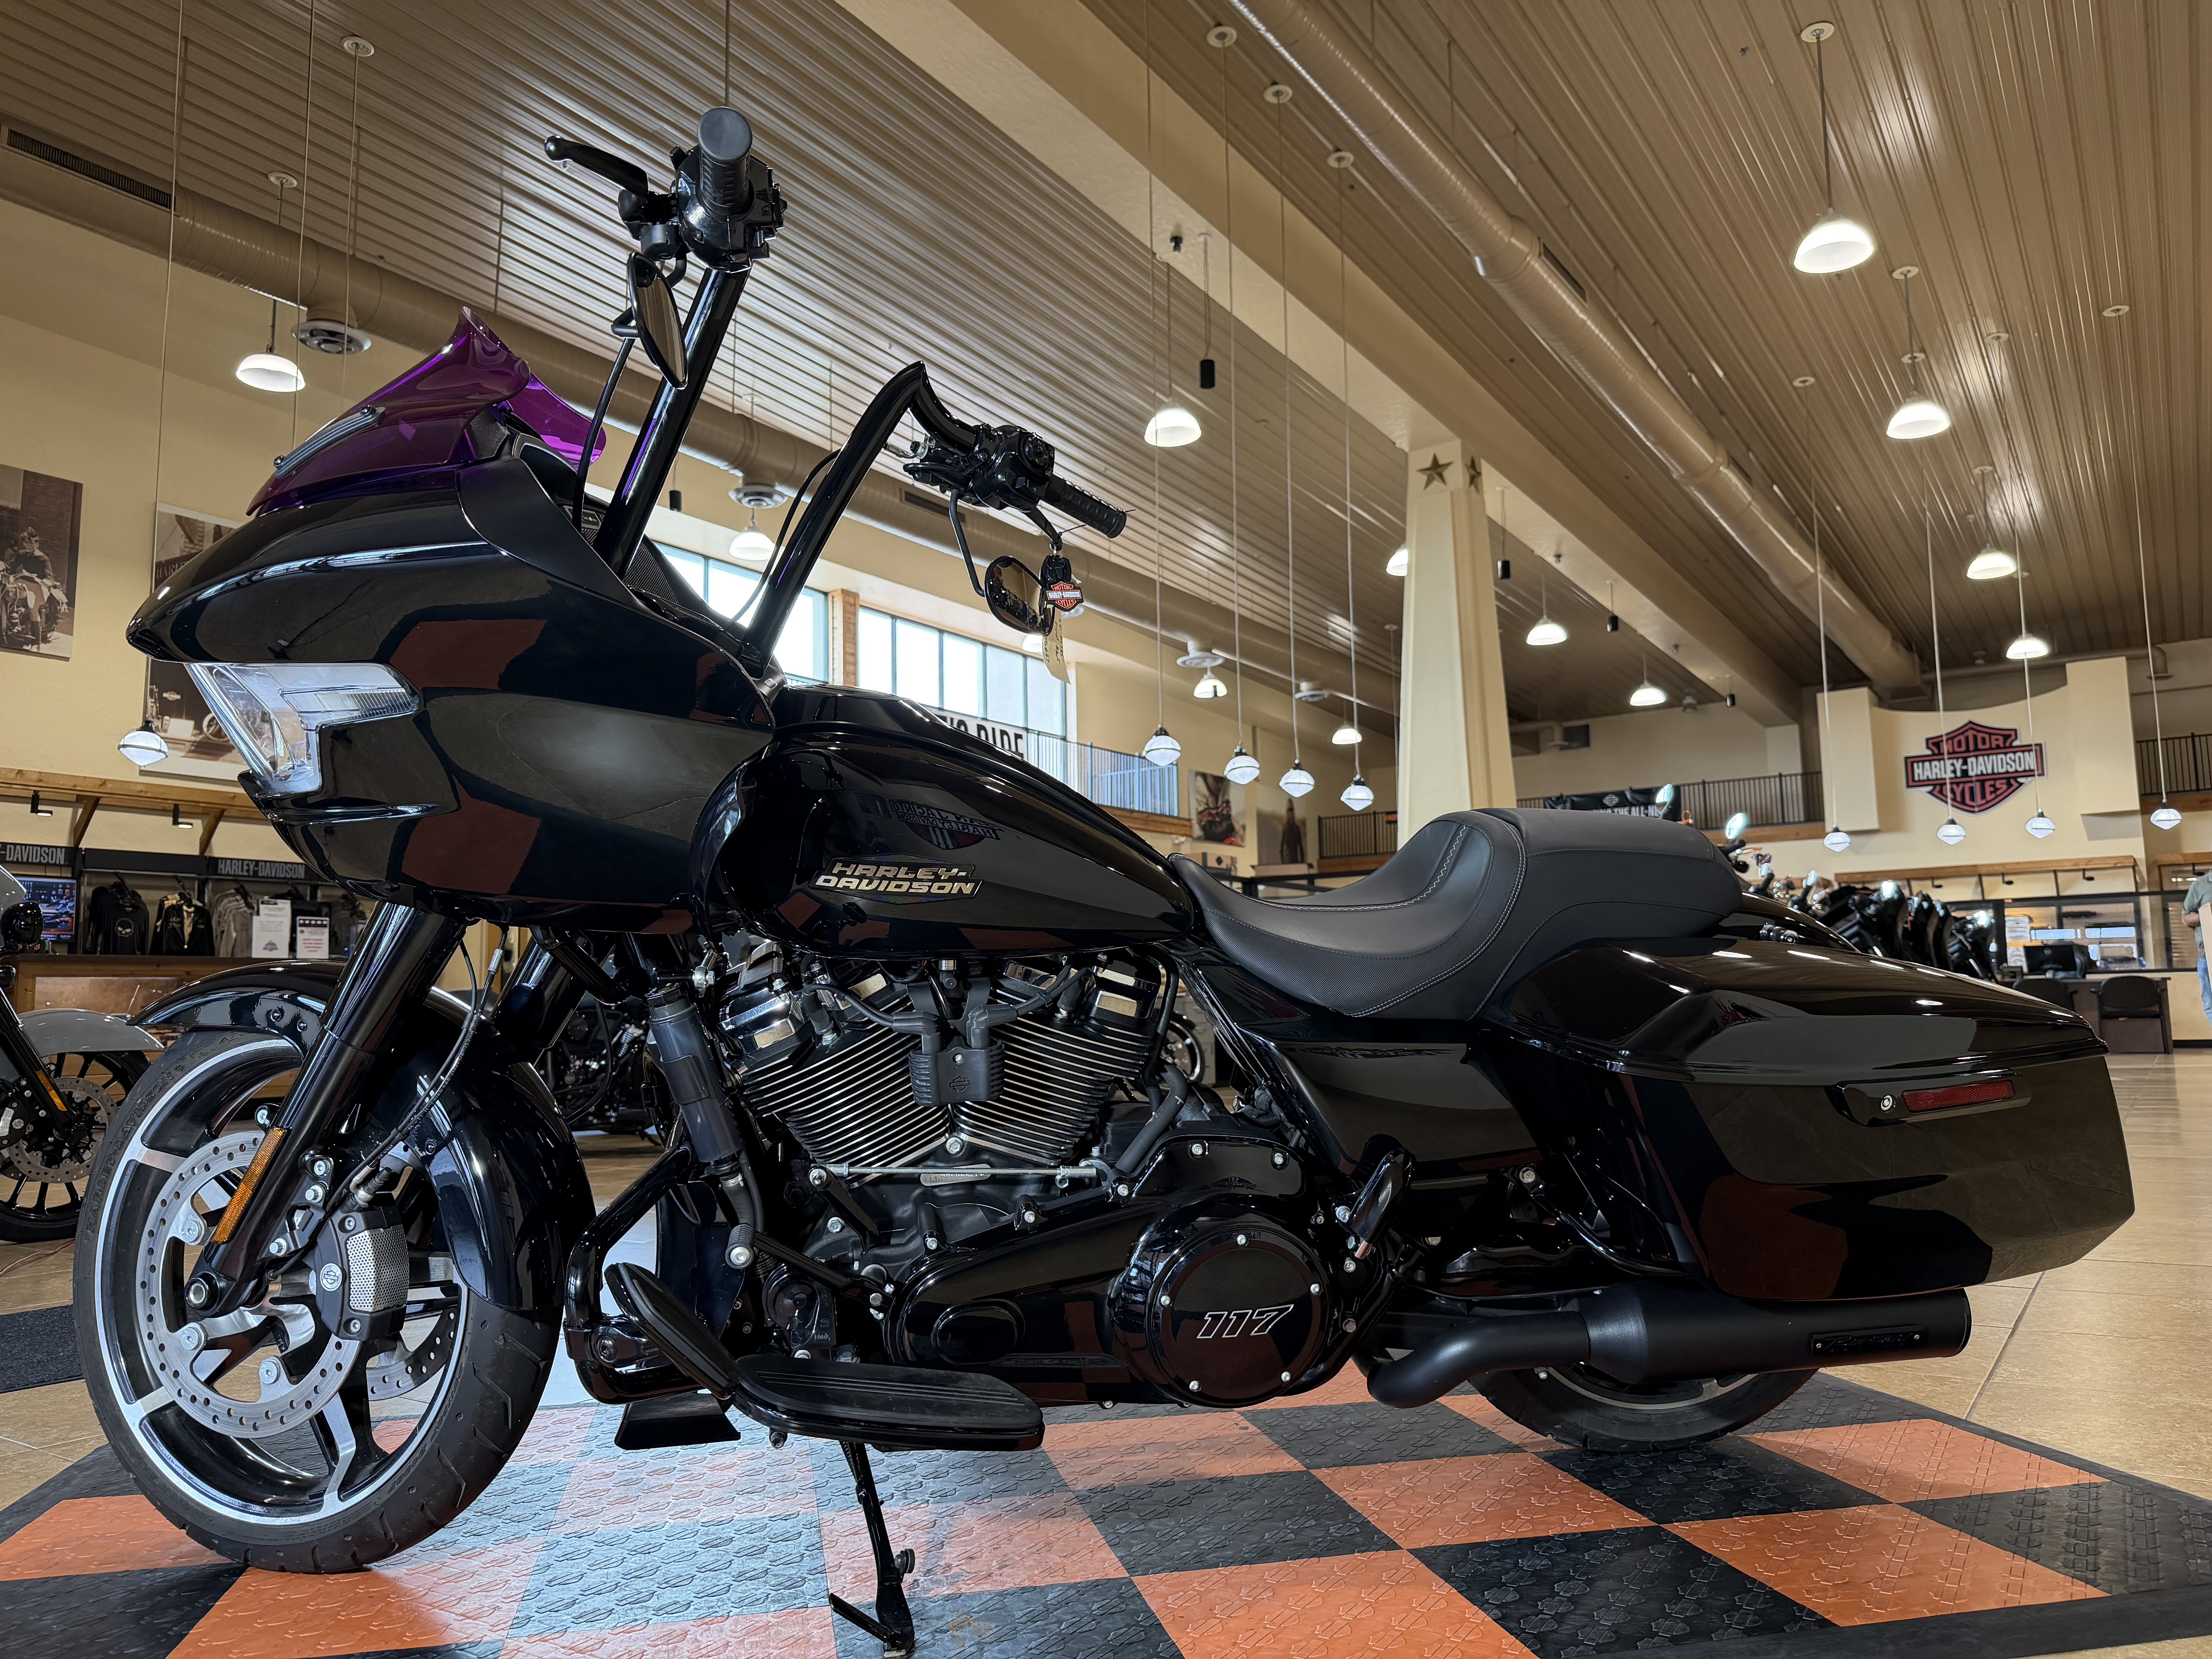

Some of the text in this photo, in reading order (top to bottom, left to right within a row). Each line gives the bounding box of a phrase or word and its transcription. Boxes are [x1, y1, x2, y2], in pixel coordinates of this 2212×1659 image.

[1940, 730, 2006, 754] MOTOR
[1913, 751, 2036, 781] HARLEY-DAVIDSON
[1942, 779, 2008, 806] CYCLES
[218, 859, 305, 879] HARLEY-DAVIDSON
[832, 862, 967, 879] HARLEY-
[815, 875, 975, 894] DAVIDSON
[85, 1070, 175, 1233] HARLEY-DAVIDSON
[1196, 1304, 1294, 1339] 117
